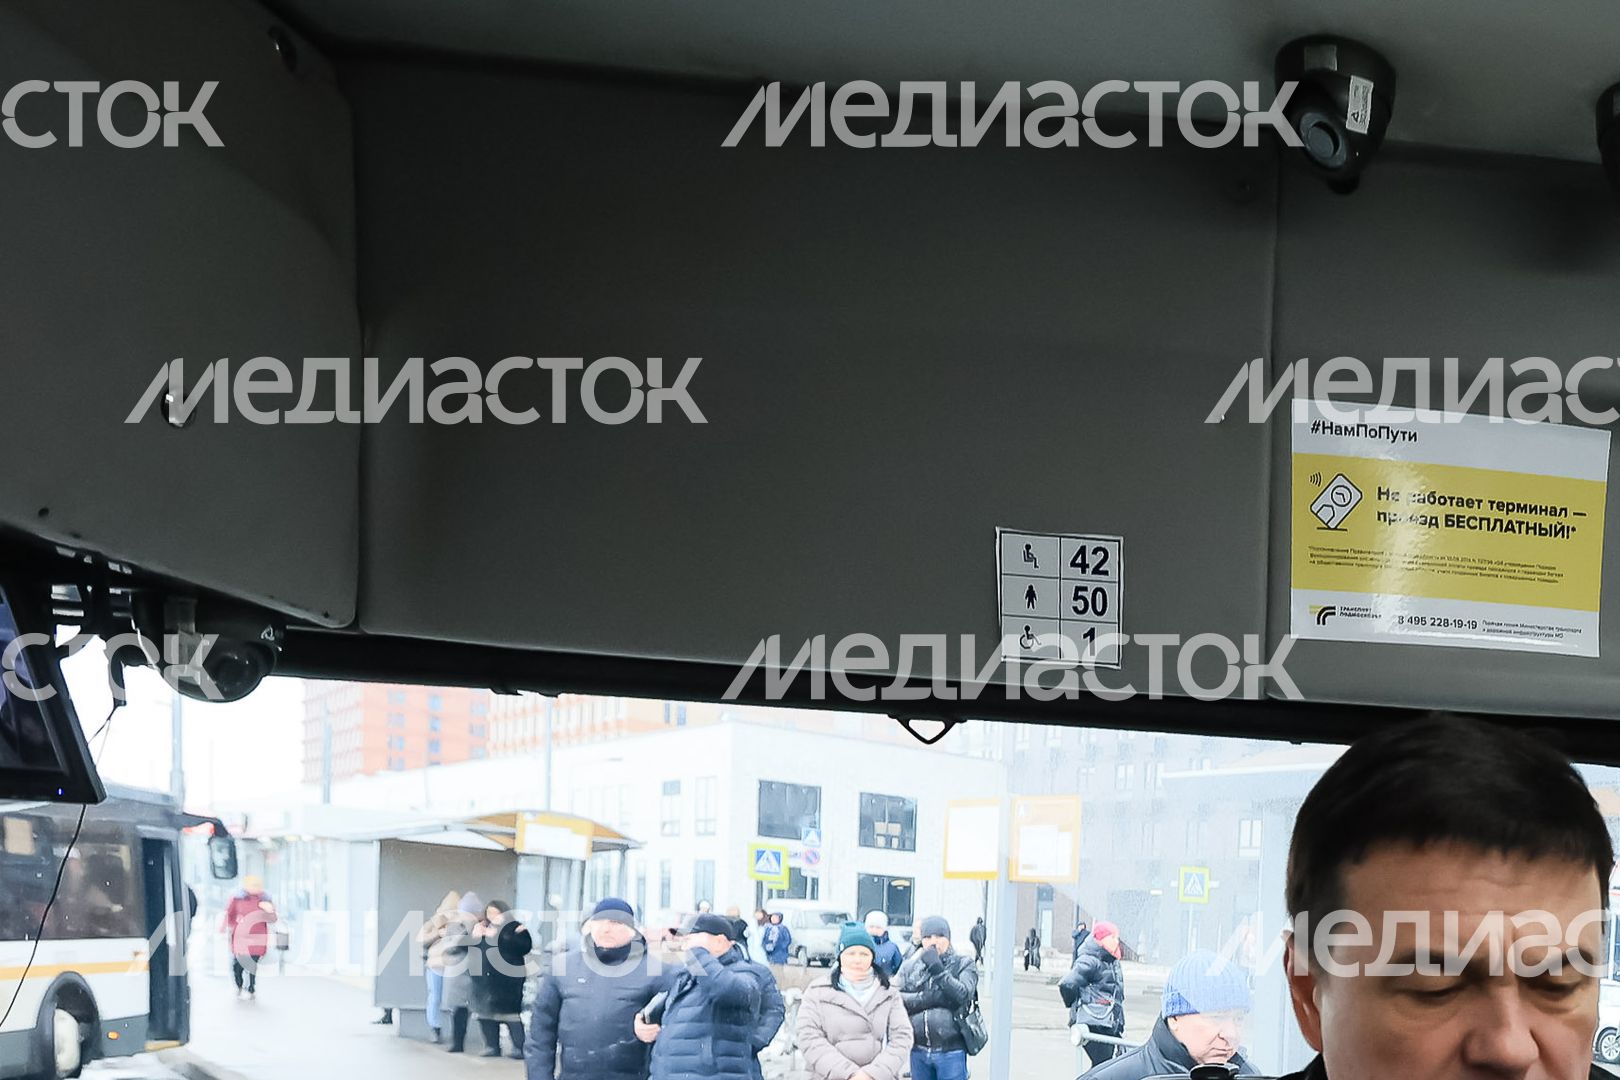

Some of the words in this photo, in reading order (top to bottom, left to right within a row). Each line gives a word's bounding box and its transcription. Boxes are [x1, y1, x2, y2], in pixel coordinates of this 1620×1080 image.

[1311, 420, 1418, 443] #НамПоПути
[1377, 486, 1401, 503] Не
[1487, 497, 1568, 518] терминал
[1069, 544, 1110, 577] 42
[1072, 586, 1108, 617] 50
[1398, 616, 1404, 625] 8
[1407, 616, 1427, 627] 495
[1430, 617, 1478, 630] 228-19-19
[1082, 627, 1097, 657] 1
